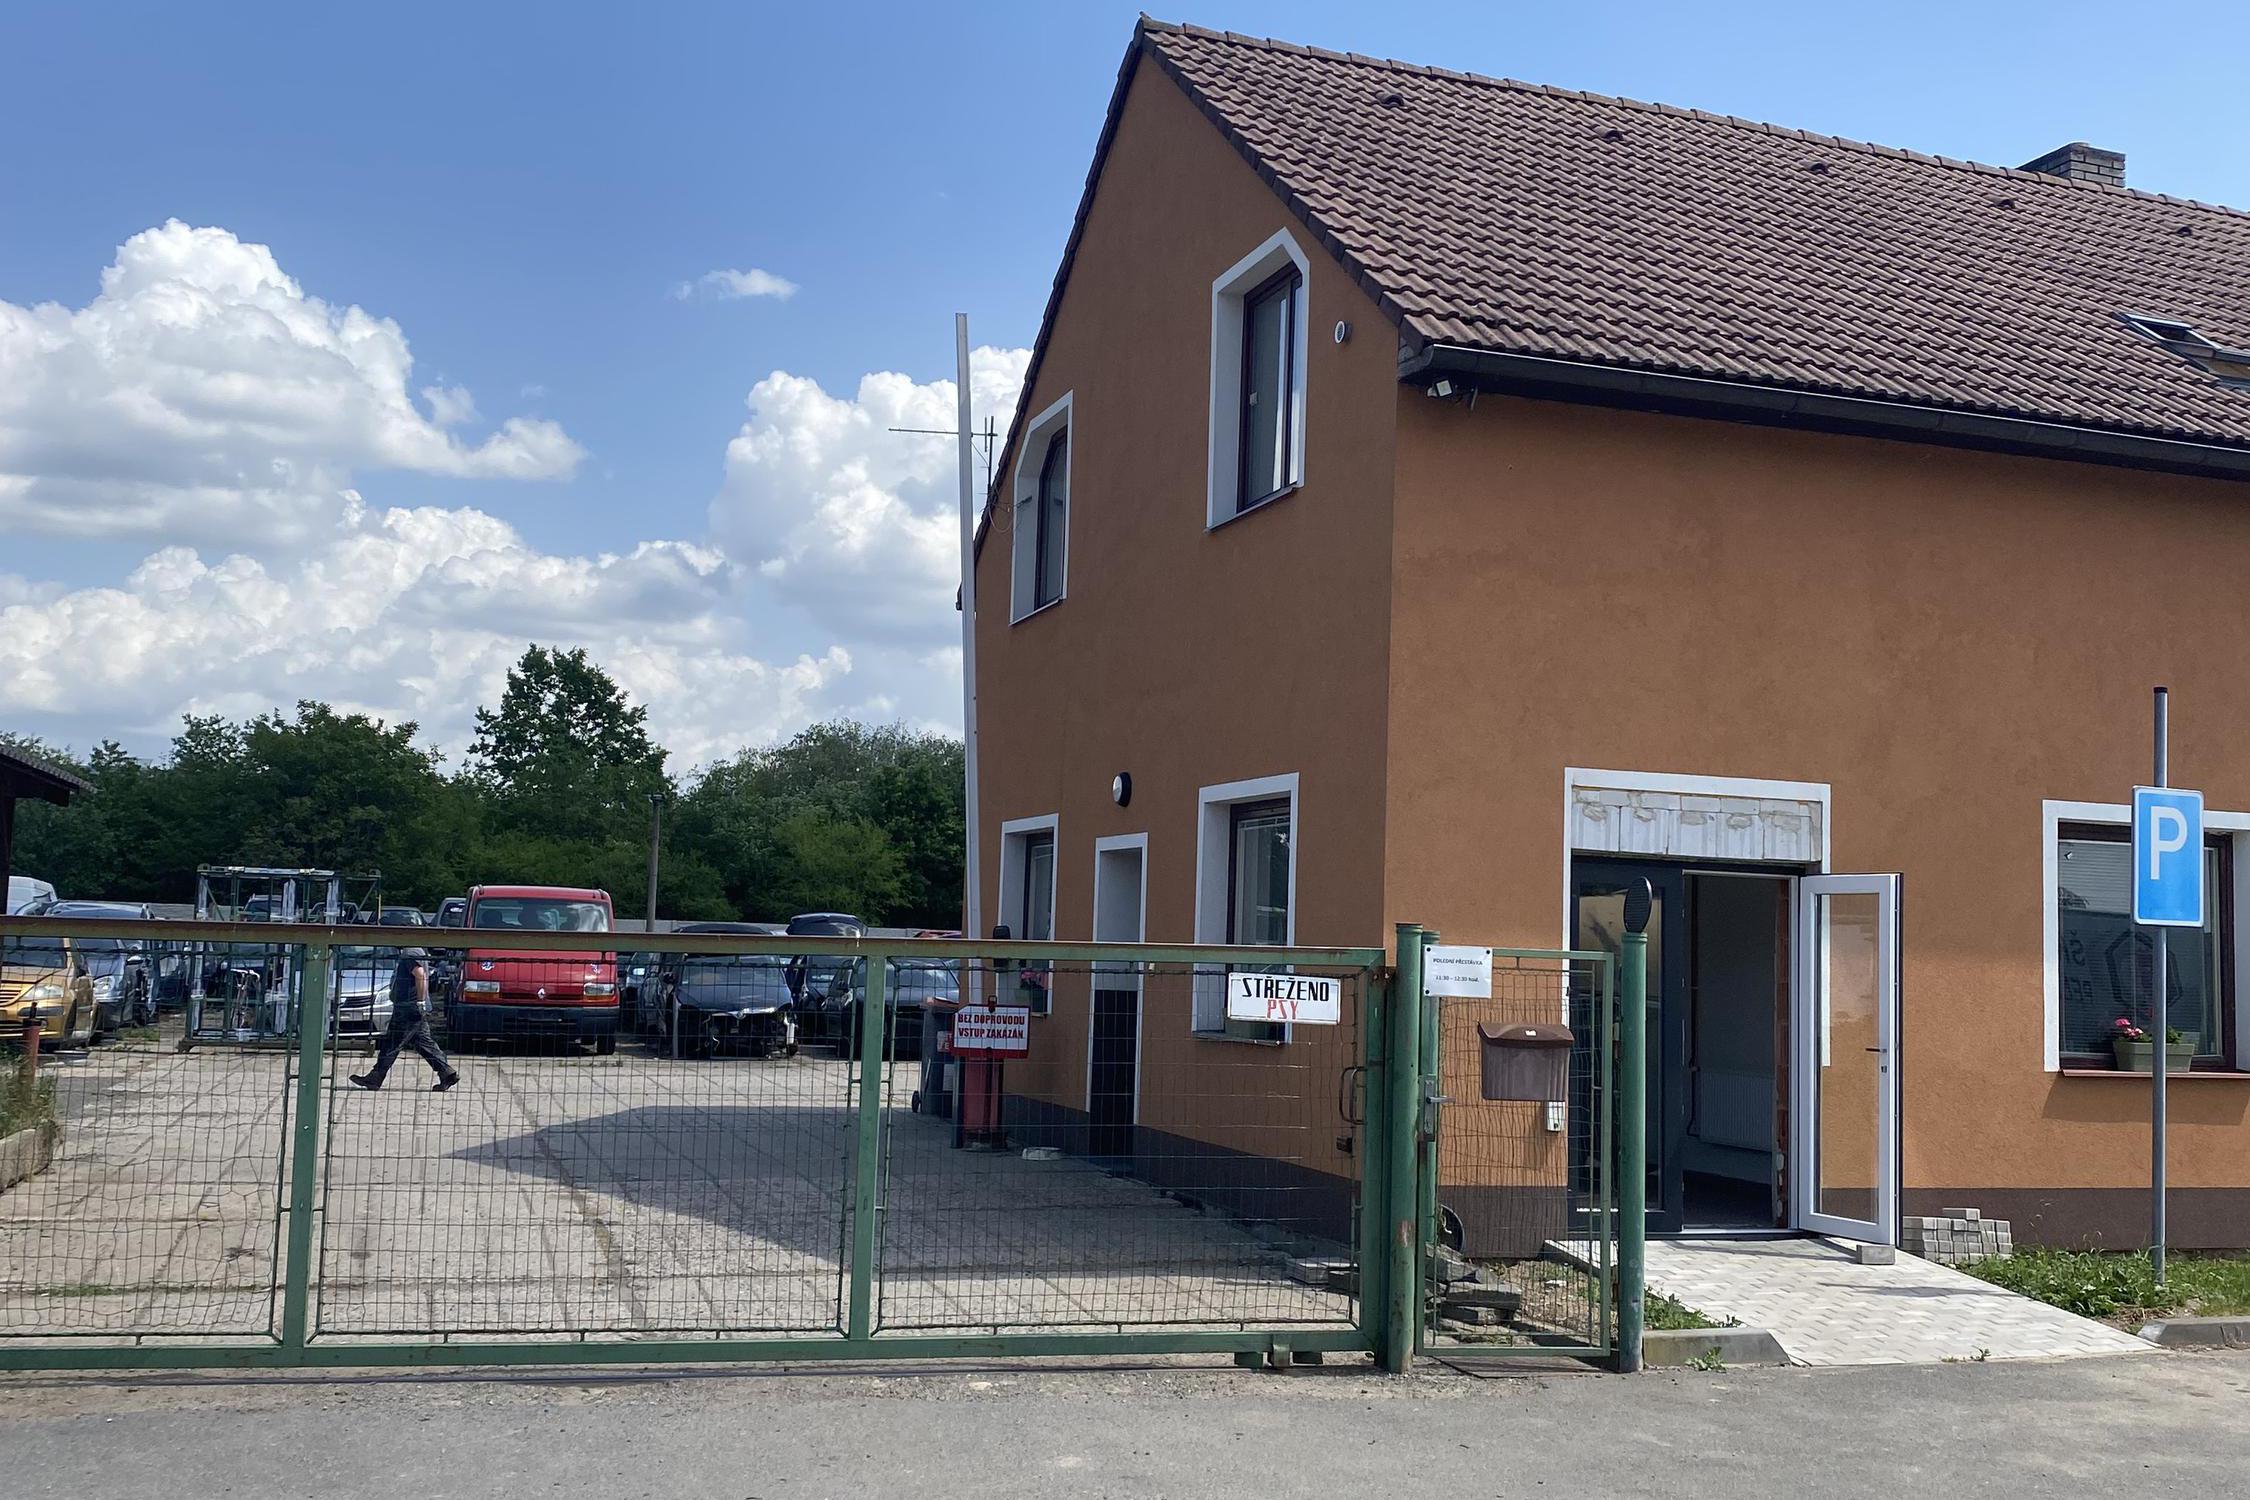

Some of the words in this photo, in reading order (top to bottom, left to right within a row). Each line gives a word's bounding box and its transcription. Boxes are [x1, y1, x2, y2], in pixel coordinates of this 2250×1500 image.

[2151, 806, 2188, 880] P
[1242, 976, 1329, 1001] STŘEŽENO
[958, 1014, 972, 1023] BEZ
[974, 1014, 1025, 1025] DOPROVODU
[1267, 999, 1298, 1020] PSY
[958, 1028, 985, 1037] VSTUP
